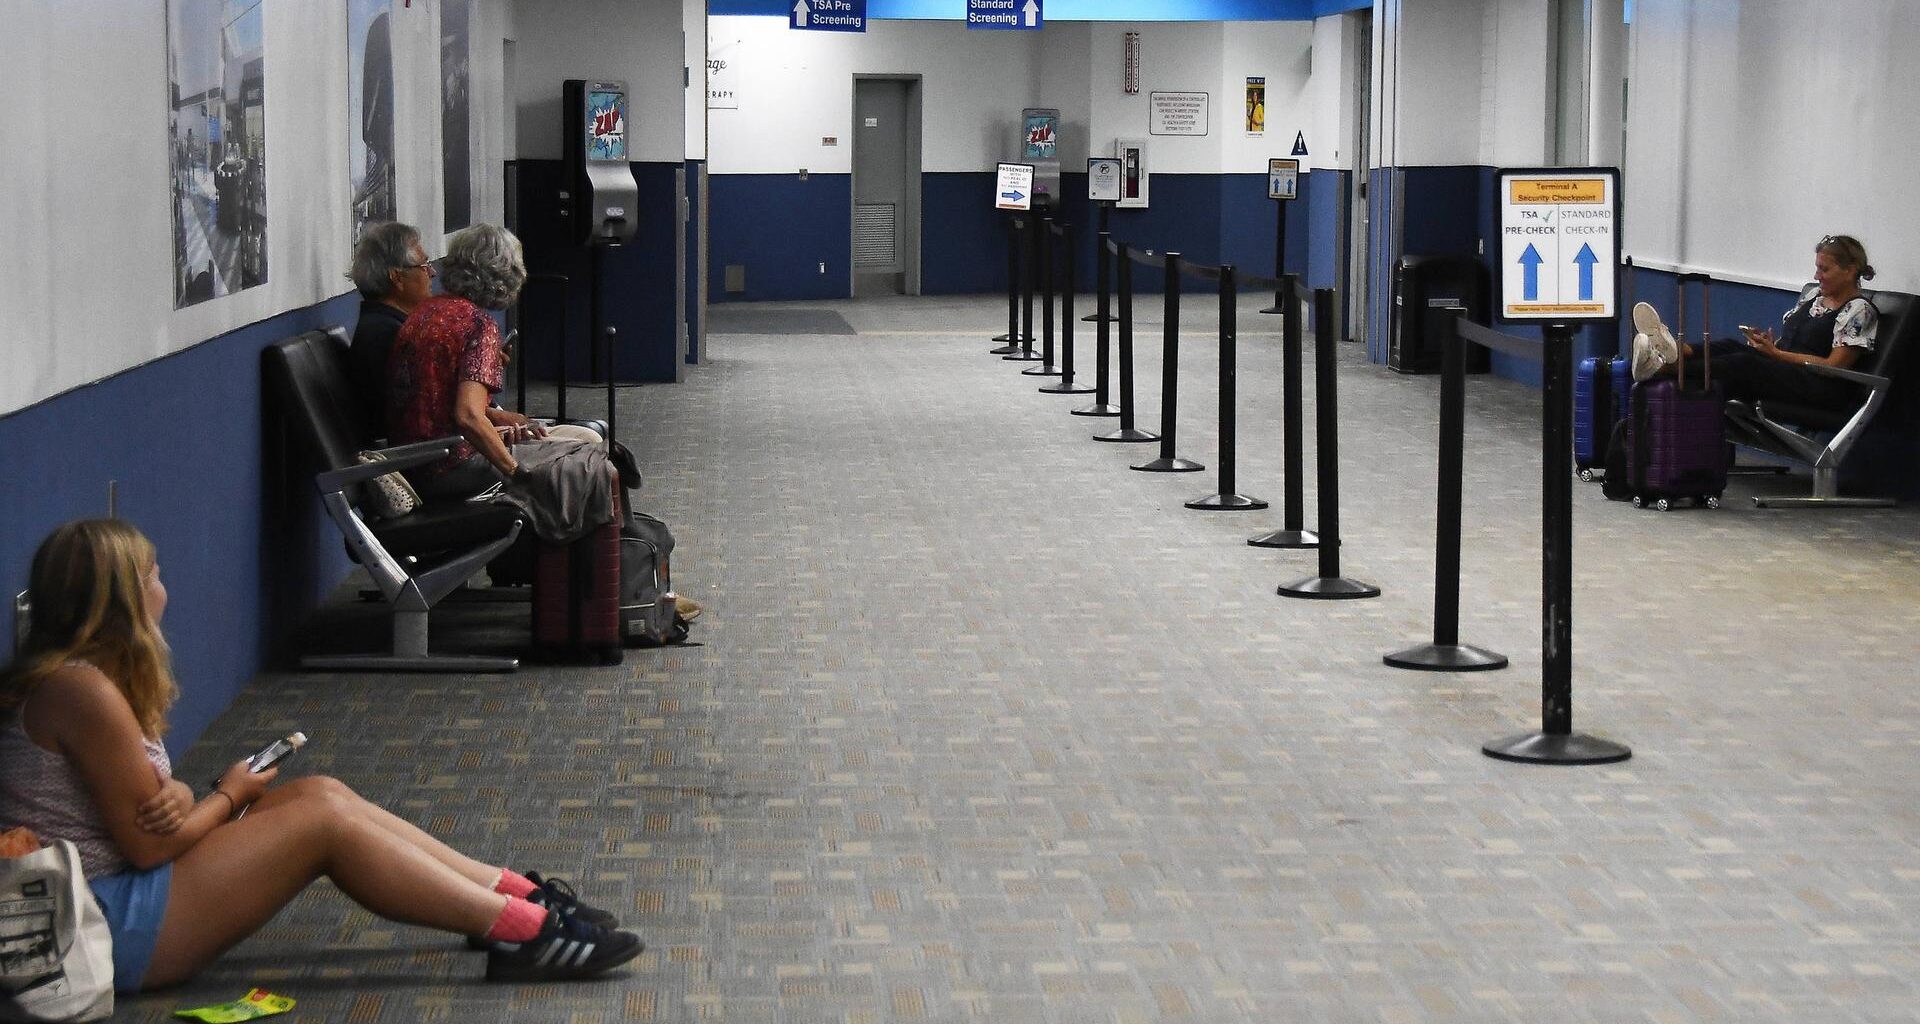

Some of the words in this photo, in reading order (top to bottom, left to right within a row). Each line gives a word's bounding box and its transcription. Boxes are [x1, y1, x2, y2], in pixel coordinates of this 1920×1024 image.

[812, 0, 832, 10] TSA
[834, 0, 851, 11] Pre
[971, 0, 1014, 9] Standard
[812, 14, 862, 27] Screening
[969, 13, 1018, 25] Screening
[595, 109, 620, 137] ZAP
[1031, 126, 1052, 144] ZAP
[1518, 194, 1549, 202] Security
[1552, 194, 1596, 203] Checkpoint
[1561, 210, 1611, 219] STANDARD
[1505, 226, 1556, 235] PRE-CHECK
[1566, 226, 1609, 235] CHECK-IN
